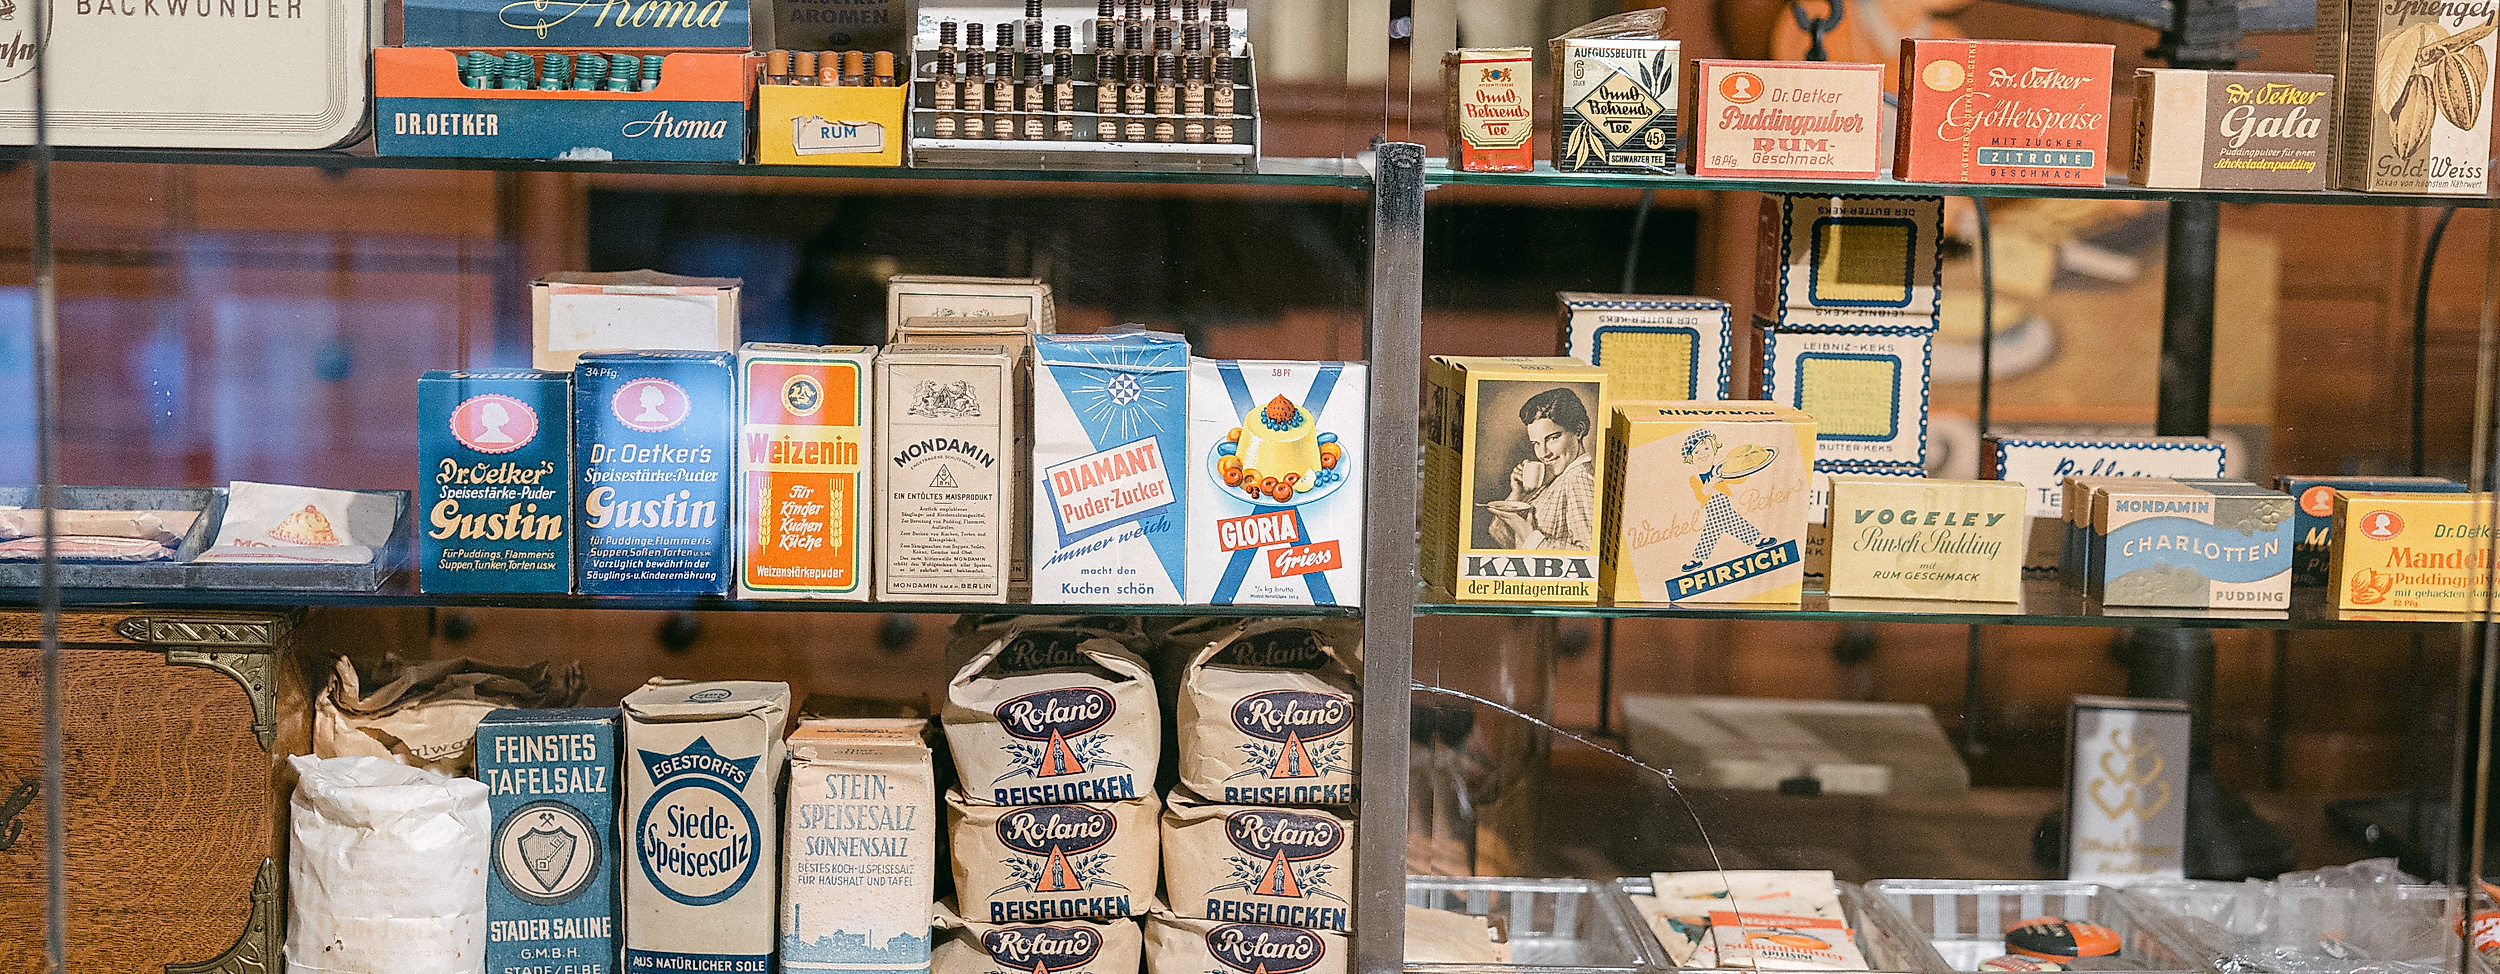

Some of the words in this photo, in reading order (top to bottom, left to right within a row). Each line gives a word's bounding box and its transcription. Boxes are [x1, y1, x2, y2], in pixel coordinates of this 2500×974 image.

[790, 8, 888, 24] AROMEN
[1574, 47, 1648, 59] AUFGUSSBEUTEL
[1573, 60, 1585, 80] 6
[1464, 103, 1530, 120] Behrends
[1587, 98, 1653, 117] Behrends
[1937, 91, 2102, 141] Götterspeise
[395, 112, 498, 137] DR.OETKER
[622, 109, 728, 139] Aroma
[1481, 121, 1510, 136] Tee
[1604, 117, 1633, 134] Tee
[1718, 105, 1864, 136] Puddingpulver
[2219, 104, 2321, 149] Gala
[820, 125, 857, 139] RUM
[1991, 137, 2016, 146] MIT
[2025, 138, 2083, 147] ZUCKER
[1611, 154, 1650, 164] SCHWARZER
[1650, 155, 1664, 165] TEE
[1711, 155, 1720, 165] 18
[1721, 154, 1739, 168] Pfg.
[1752, 152, 1834, 166] Geschmack
[1990, 152, 2082, 165] ZITRONE
[2219, 147, 2281, 159] Puddingpulver
[2281, 147, 2294, 158] für
[1990, 168, 2081, 179] GESCHMACK
[2213, 158, 2316, 174] Schokoladenpudding
[2431, 156, 2482, 179] Weiss
[1894, 207, 1916, 217] DER
[1597, 314, 1680, 325] BUTTER-KEKS
[1681, 316, 1699, 326] DER
[1802, 342, 1896, 353] LEIBNIZ-KEKS
[585, 367, 600, 377] 34
[599, 367, 620, 380] Pfg.
[1271, 367, 1283, 377] 38
[746, 432, 858, 465] Weizenin
[893, 437, 996, 469] MONDAMIN
[1818, 444, 1893, 454] BUTTER-KEKS
[1053, 443, 1159, 499] DIAMANT
[439, 485, 557, 500] Speisestärke-Puder
[788, 484, 815, 500] Für
[893, 492, 905, 500] EIN
[907, 491, 943, 501] ENTÖLTES
[945, 493, 993, 501] MAISPRODUKT
[1062, 477, 1166, 525] Puder-Zucker
[585, 485, 717, 529] Gustin
[779, 501, 824, 519] Kinder
[1627, 505, 1703, 550] Wackel
[1738, 478, 1804, 517] Peter
[2115, 500, 2209, 514] MONDAMIN
[428, 498, 563, 541] Gustin
[779, 518, 823, 536] Kuchen
[1854, 508, 2006, 528] VOGELEY
[1221, 512, 1298, 550] GLORIA
[589, 536, 604, 545] für
[605, 536, 655, 547] Puddinge,
[655, 536, 713, 546] Flammeris,
[778, 534, 823, 552] Küche
[1041, 536, 1114, 571] immer
[1118, 514, 1171, 543] weich
[1852, 525, 1922, 554] Punsch
[1921, 528, 2002, 560] Pudding
[2122, 534, 2280, 563] CHARLOTTEN
[442, 548, 458, 558] Für
[458, 548, 503, 561] Puddings,
[504, 548, 555, 559] Flammeris
[1274, 546, 1333, 576] Griess
[592, 559, 644, 570] Vorzüglich
[645, 559, 685, 569] bewährt
[684, 560, 693, 568] in
[693, 560, 710, 568] der
[756, 564, 844, 580] Weizenstärkepuder
[1080, 566, 1113, 576] macht
[1116, 566, 1136, 576] den
[1465, 556, 1595, 579] KABA
[1678, 545, 1788, 596] PFIRSICH
[1919, 562, 1937, 570] mit
[1873, 570, 1902, 580] RUM
[1904, 571, 1981, 582] GESCHMACK
[1061, 581, 1110, 595] Kuchen
[1116, 581, 1155, 595] schön
[1467, 580, 1490, 596] der
[1492, 580, 1590, 598] Plantagentrank
[2215, 590, 2284, 603] PUDDING
[2394, 589, 2411, 597] mit
[2414, 589, 2466, 599] gehackten
[1005, 693, 1105, 732] Roland
[1243, 693, 1345, 733] Roland
[494, 733, 597, 763] FEINSTES
[651, 753, 747, 786] EGESTORFFS
[487, 766, 607, 796] TAFELSALZ
[825, 773, 894, 801] STEIN-
[667, 803, 735, 840] Siede-
[799, 803, 916, 831] SPEISESALZ
[1006, 812, 1106, 848] Roland
[1235, 813, 1334, 851] Roland
[645, 822, 750, 879] Speisesalz
[804, 835, 909, 858] SONNENSALZ
[797, 862, 831, 874] BESTES
[797, 874, 816, 885] FÜR
[818, 874, 864, 886] HAUSHALT
[866, 875, 886, 886] UND
[887, 875, 914, 886] TAFEL
[989, 894, 1132, 922] REISFLOCKEN
[1206, 898, 1348, 931] REISFLOCKEN
[490, 918, 551, 943] STADER
[552, 916, 613, 941] SALINE
[520, 946, 581, 959] G.M.B.H.
[992, 930, 1094, 964] Roland
[1216, 928, 1316, 962] Roland
[632, 955, 653, 967] AUS
[655, 955, 741, 972] NATÜRLICHER
[742, 958, 766, 972] SOLE
